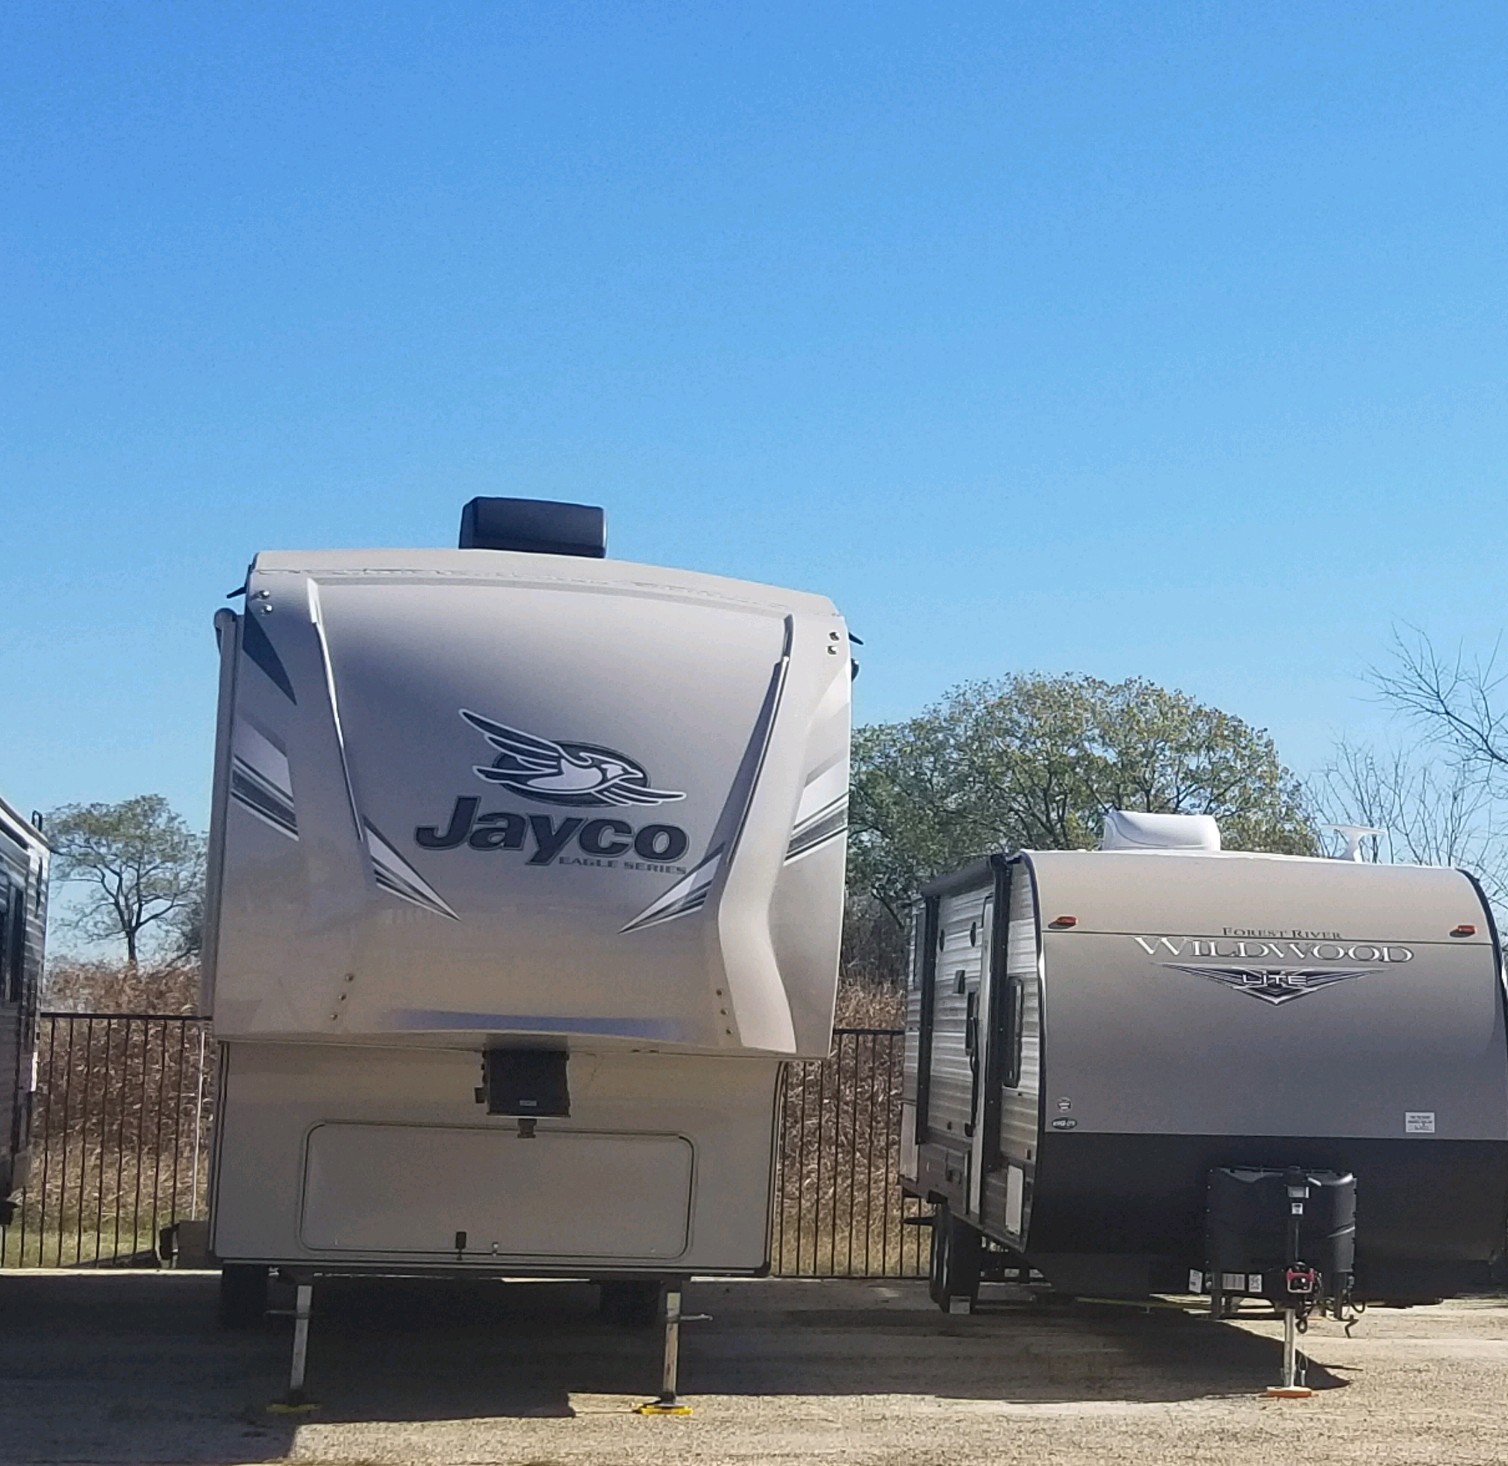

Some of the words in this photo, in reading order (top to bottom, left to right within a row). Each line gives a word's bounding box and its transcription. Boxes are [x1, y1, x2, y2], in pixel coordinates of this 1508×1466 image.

[414, 796, 690, 866] Jayco
[559, 856, 619, 869] EAGLE
[623, 861, 687, 875] SERIES
[1222, 927, 1288, 939] FOREST
[1291, 929, 1342, 940] RIVER
[1134, 937, 1414, 962] WILDWOOD
[1242, 972, 1308, 986] LITE
